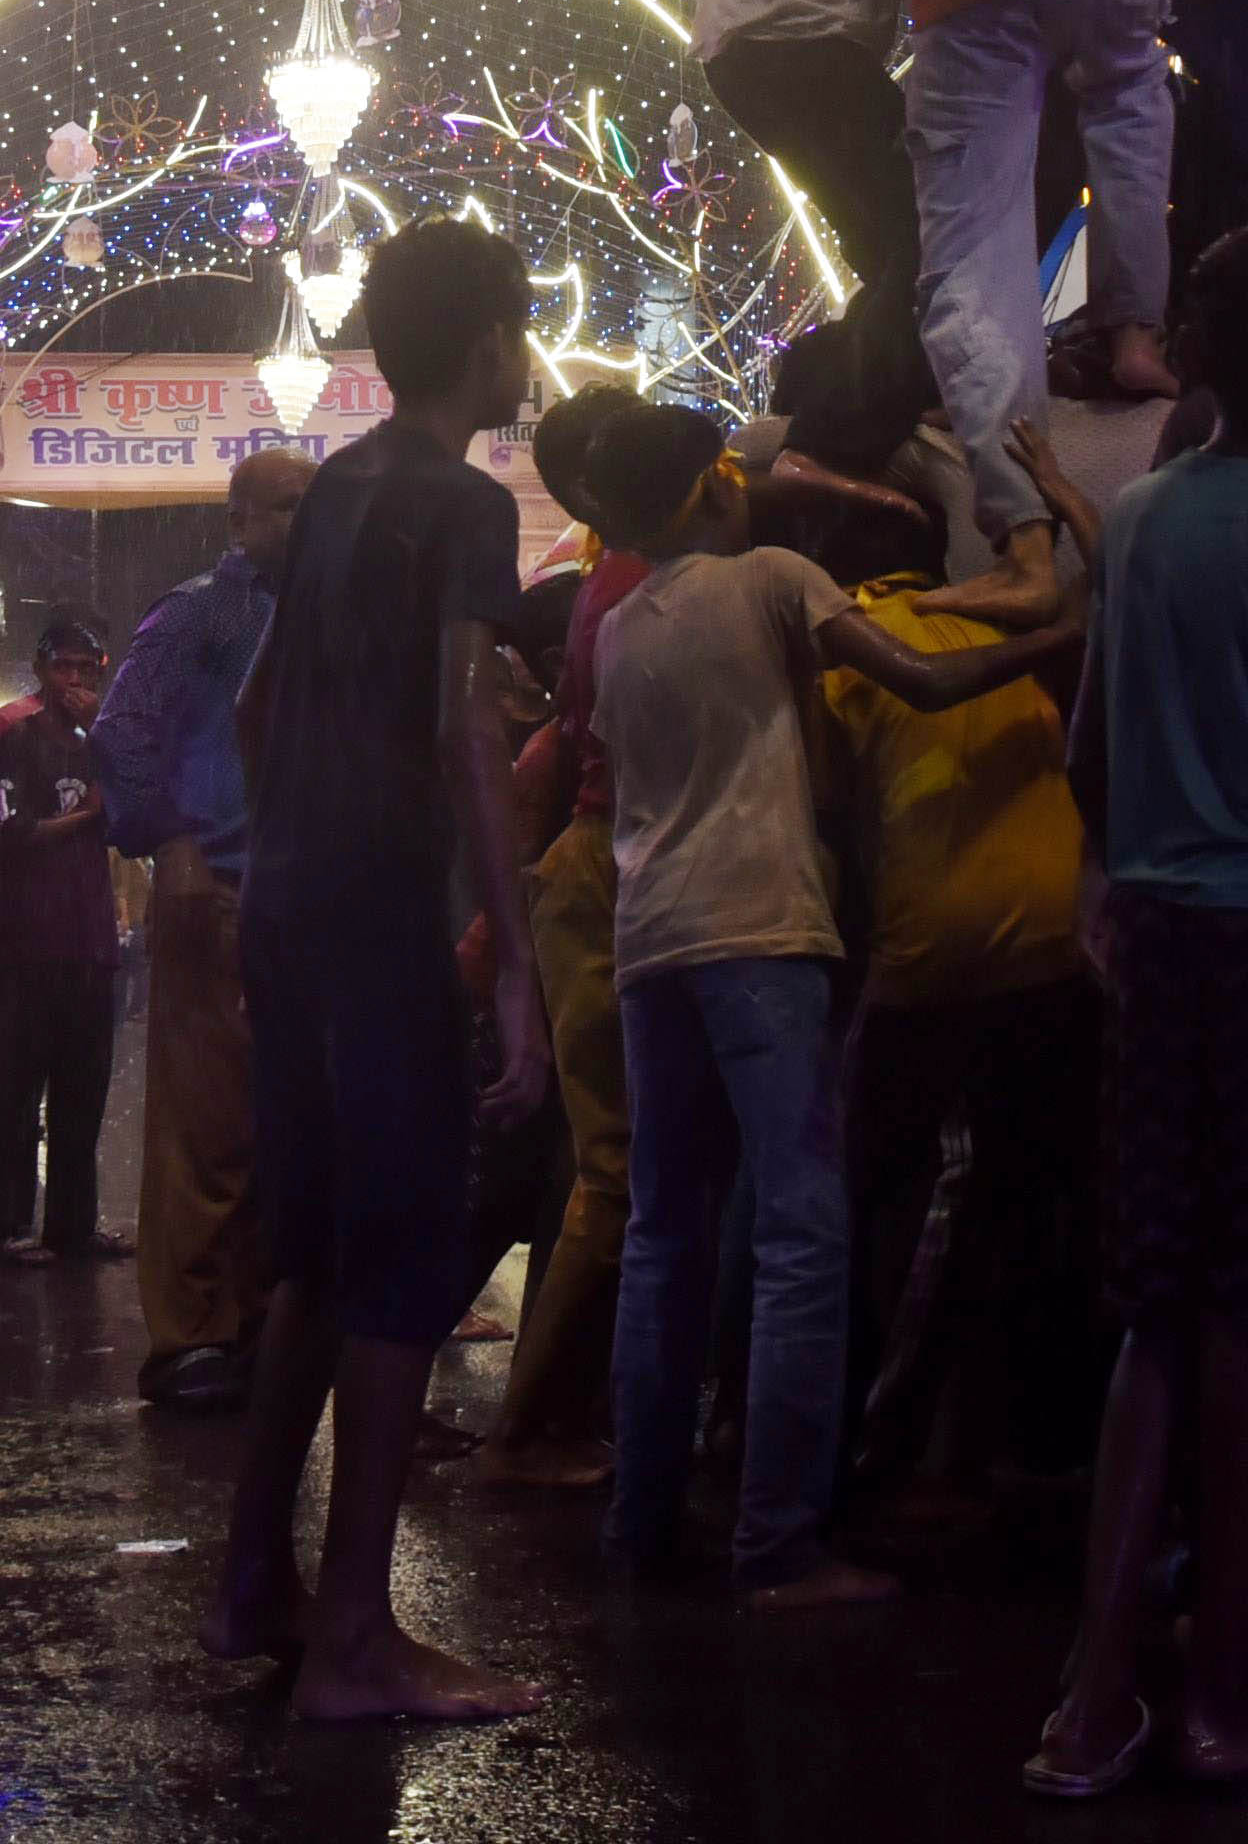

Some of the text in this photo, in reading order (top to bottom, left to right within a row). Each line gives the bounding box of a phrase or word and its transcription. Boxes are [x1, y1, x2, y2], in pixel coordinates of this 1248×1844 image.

[20, 367, 86, 418] श्री
[101, 378, 227, 430] कृष्ण
[29, 427, 198, 466] डिजिटल
